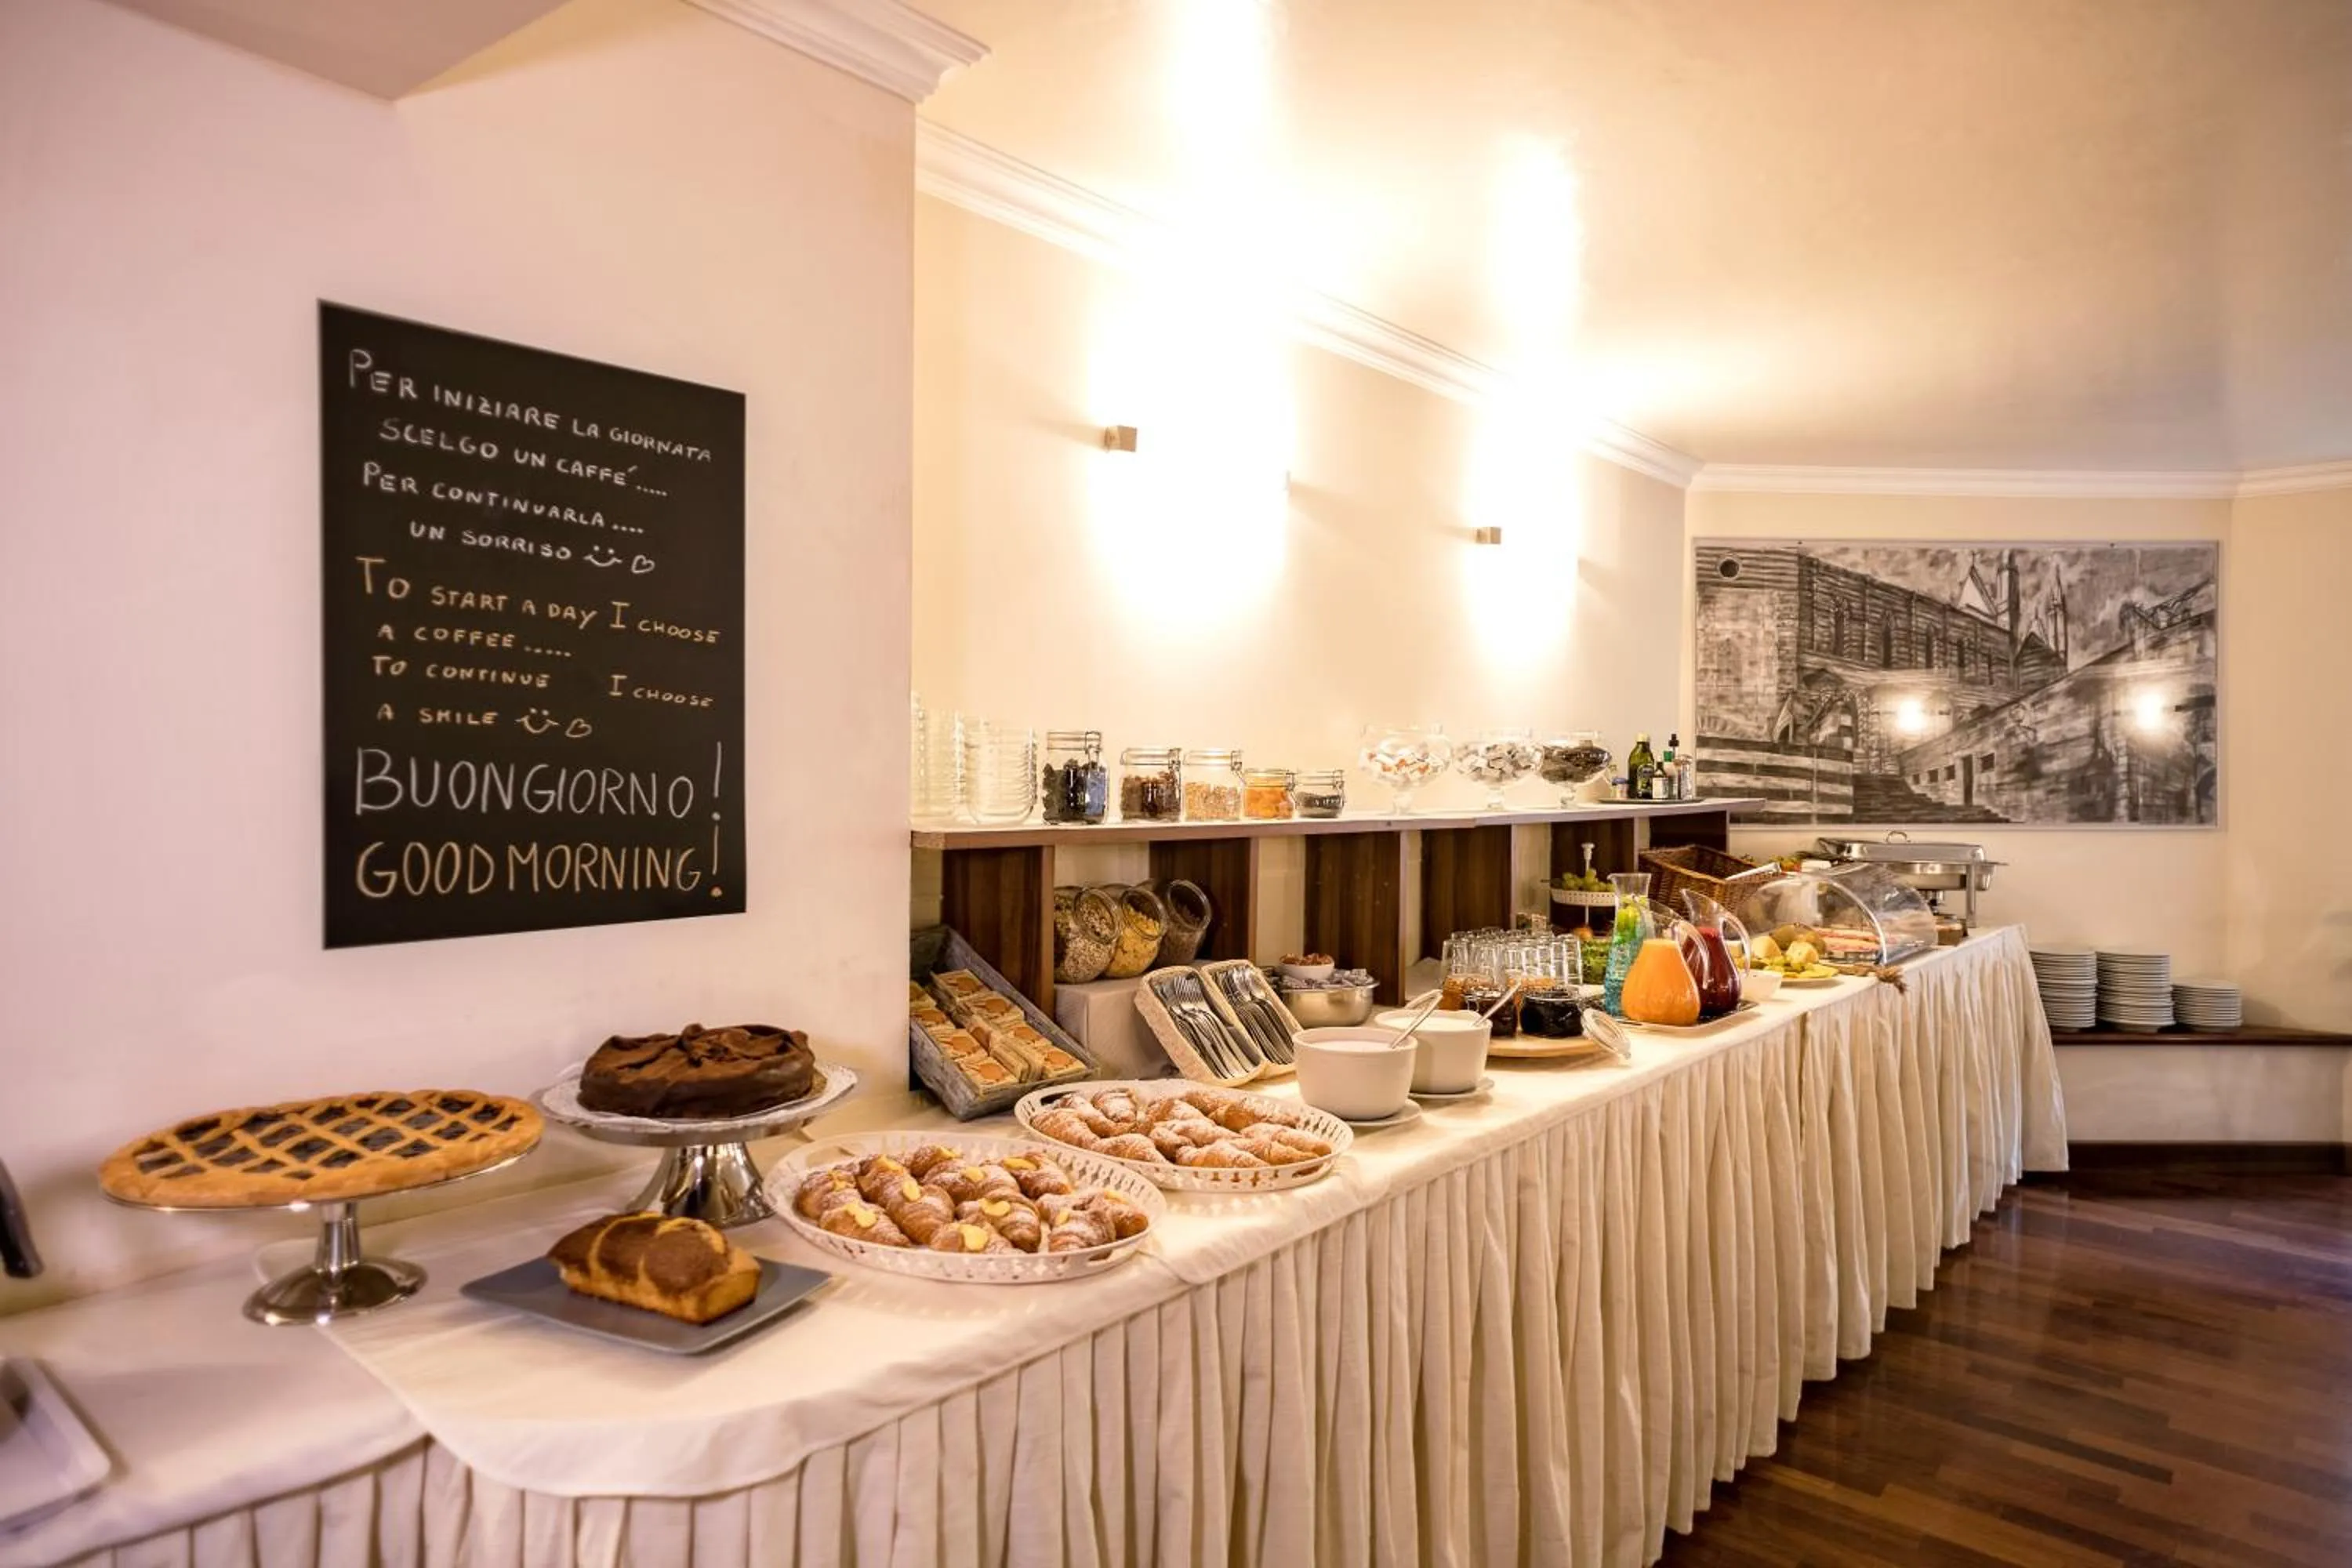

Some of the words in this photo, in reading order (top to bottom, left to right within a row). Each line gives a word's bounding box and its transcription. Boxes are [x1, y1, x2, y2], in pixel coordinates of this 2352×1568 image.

[349, 348, 419, 400] PER
[433, 384, 561, 430] INIZIARE
[572, 418, 601, 439] LA
[608, 426, 712, 463] GIORNATA
[379, 417, 499, 460] SCELGO
[513, 448, 546, 468] UN
[362, 460, 419, 495] PER
[409, 520, 446, 541] UN
[461, 529, 572, 561] SORRISO
[355, 556, 411, 600] TO
[430, 585, 509, 613] START
[521, 599, 537, 617] A
[547, 601, 599, 631] DAY
[608, 599, 632, 630] I
[637, 619, 722, 644] CHOOSE
[376, 623, 395, 642] A
[372, 655, 408, 677] TO
[426, 663, 551, 689] CONTINUE
[608, 673, 628, 697] I
[632, 687, 714, 708] CHOOSE
[376, 702, 395, 720] A
[419, 707, 499, 726] SMILE
[355, 840, 495, 898] GOOD
